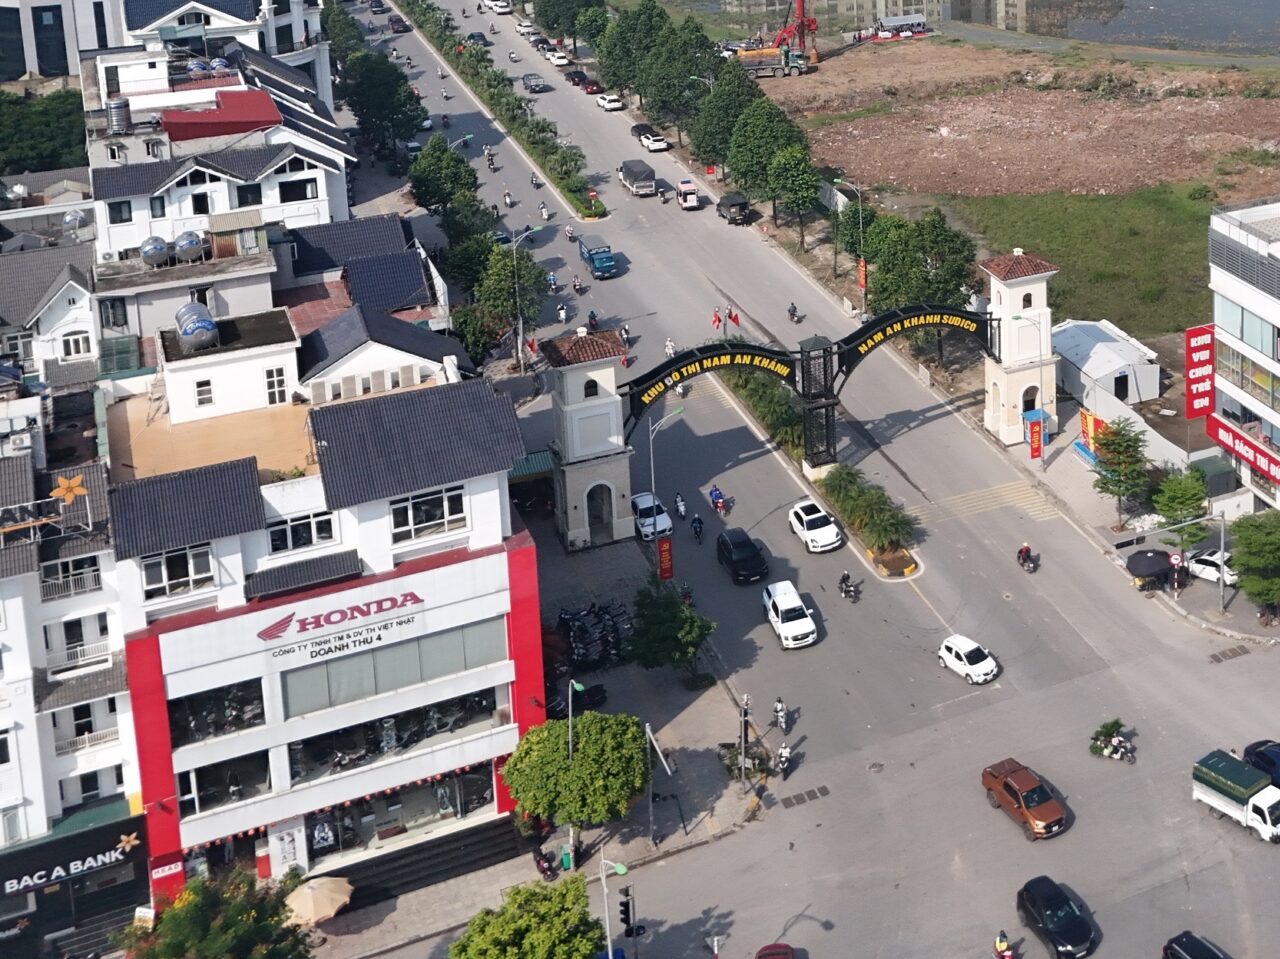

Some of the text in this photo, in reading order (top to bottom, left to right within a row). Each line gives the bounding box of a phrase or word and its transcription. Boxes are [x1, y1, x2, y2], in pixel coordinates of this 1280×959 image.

[858, 330, 885, 354] NAM
[885, 322, 902, 337] AN
[941, 314, 977, 333] SUDICO
[1190, 333, 1212, 348] KHU
[1192, 349, 1211, 363] VUI
[641, 380, 665, 406] KHU
[702, 354, 731, 369] NAM
[734, 354, 752, 365] AN
[1193, 396, 1210, 410] EM
[1234, 438, 1255, 462] SÁCH
[296, 591, 424, 634] HONDA
[272, 644, 297, 658] CÔNG
[297, 642, 309, 652] TY
[310, 638, 332, 650] TNHH
[333, 634, 345, 643] TM
[352, 630, 364, 639] DV
[365, 627, 376, 636] TH
[309, 633, 383, 660] DOANH THU 4
[4, 847, 126, 894] BAC A BANK
